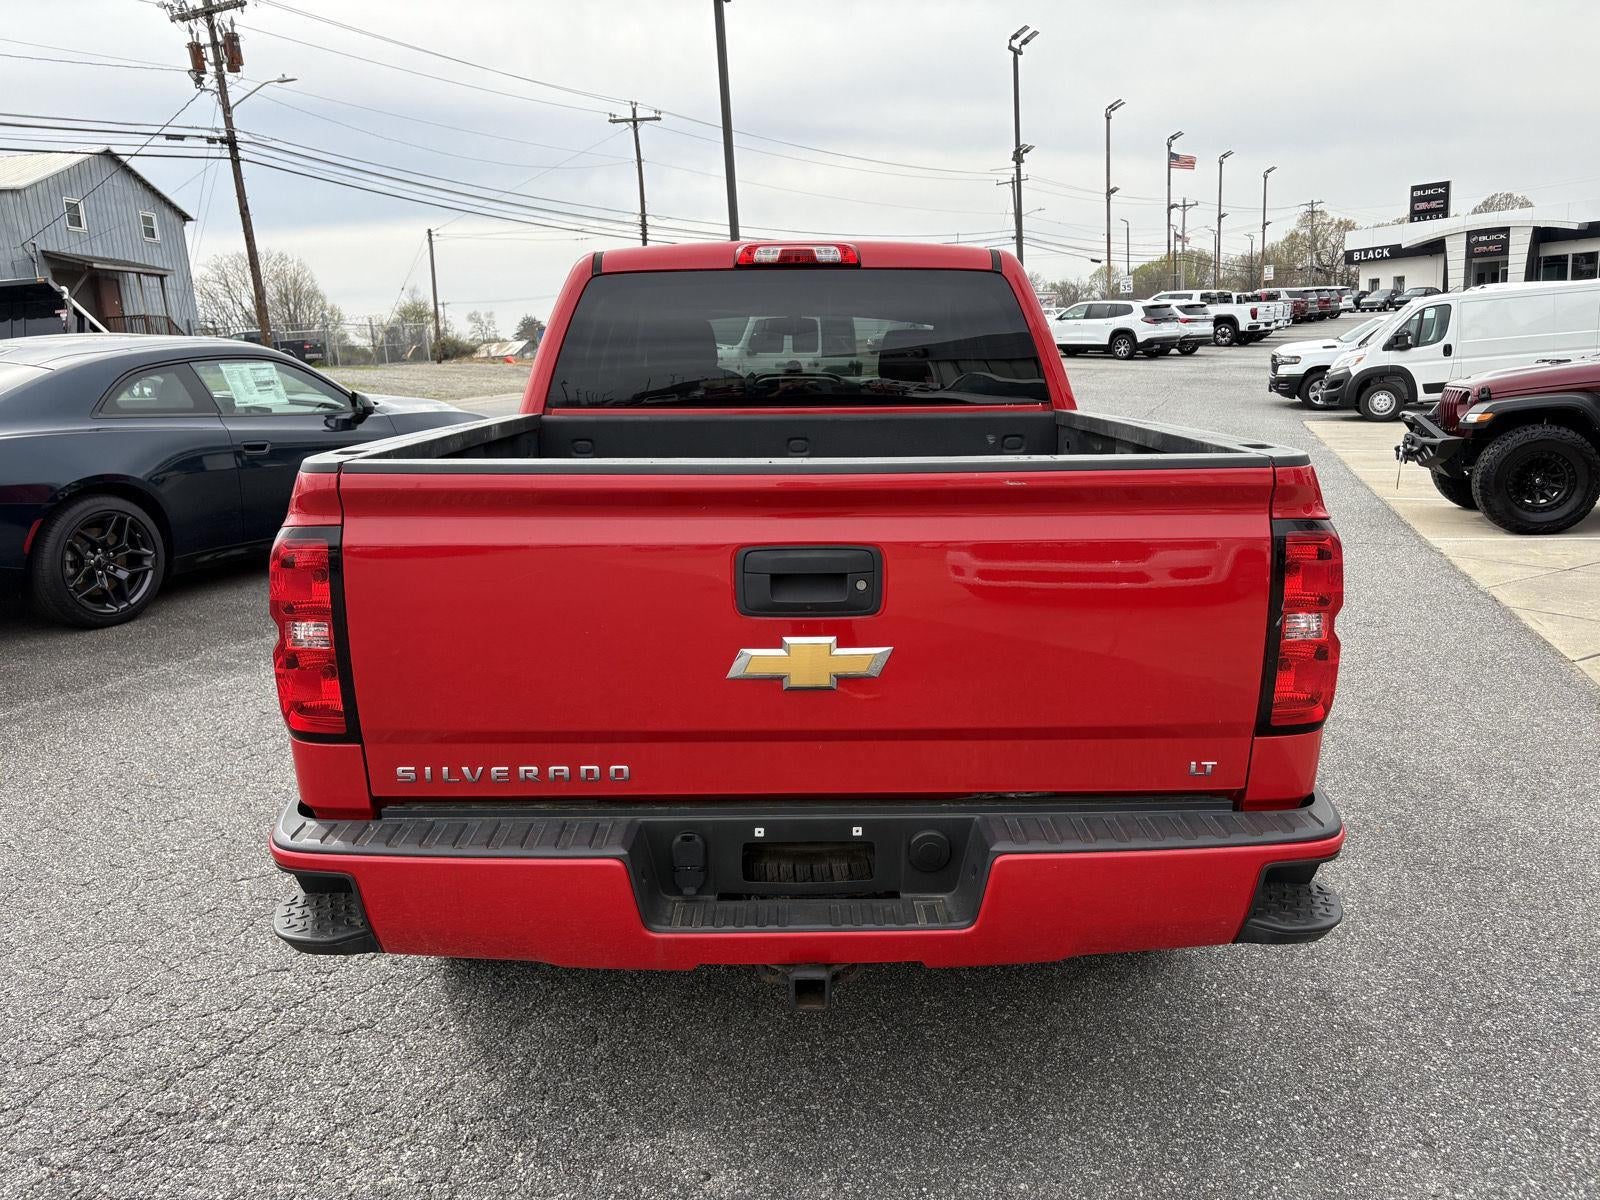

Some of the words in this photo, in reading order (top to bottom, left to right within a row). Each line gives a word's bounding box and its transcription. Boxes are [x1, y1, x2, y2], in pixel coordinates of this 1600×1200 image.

[1413, 187, 1446, 196] BUICK
[1414, 200, 1444, 210] GMC
[1413, 213, 1443, 221] BLACK
[1479, 233, 1507, 241] BUICK
[1474, 244, 1502, 253] GMC
[1353, 247, 1390, 260] BLACK
[1190, 761, 1218, 776] LT
[396, 765, 631, 783] SILVERADO
